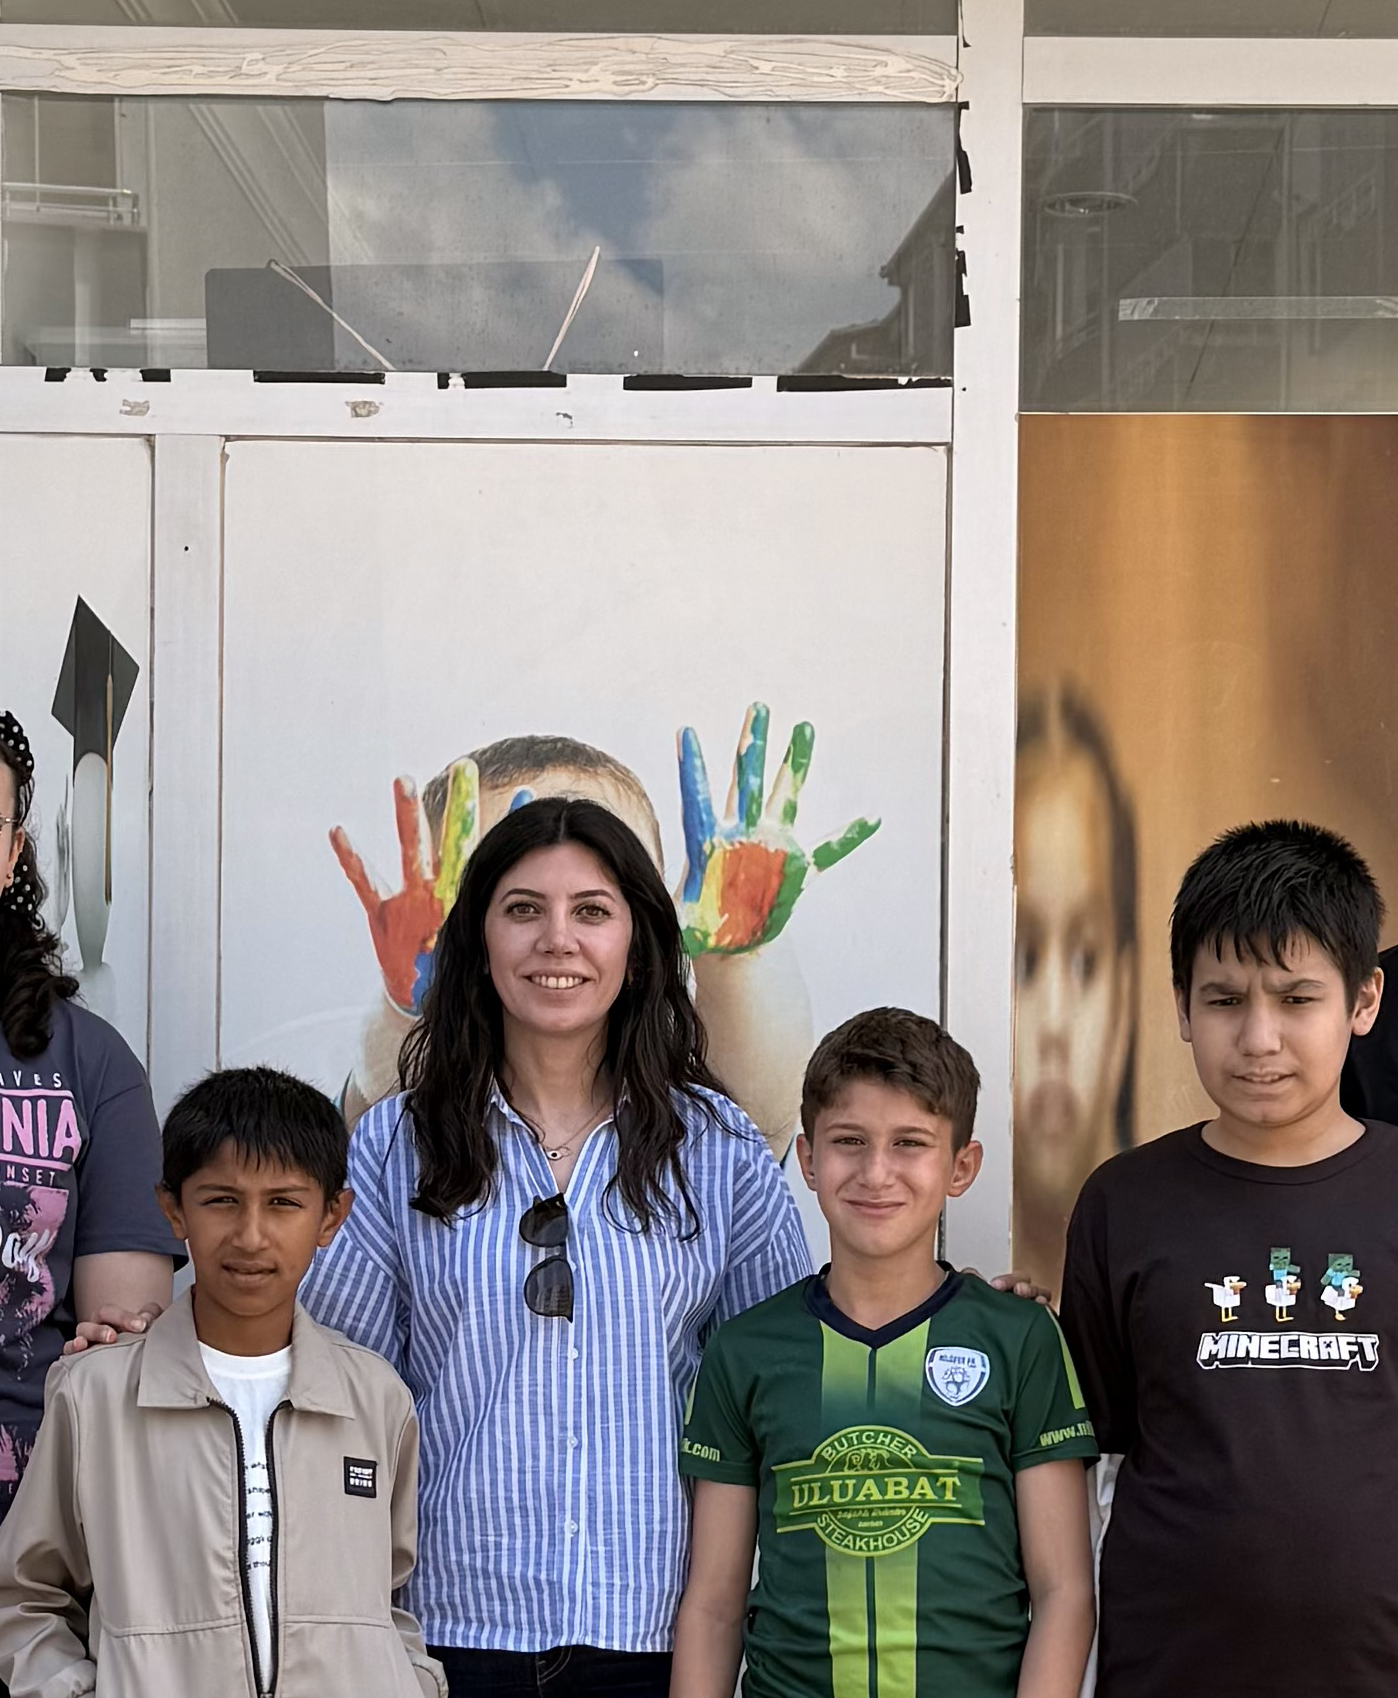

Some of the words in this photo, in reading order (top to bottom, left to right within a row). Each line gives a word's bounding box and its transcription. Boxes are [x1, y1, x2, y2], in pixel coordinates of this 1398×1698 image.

[1197, 1332, 1379, 1370] MINECRAFT
[821, 1431, 918, 1462] BUTCHER
[791, 1475, 960, 1509] ULUABAT
[817, 1507, 929, 1551] STEAKHOUSE
